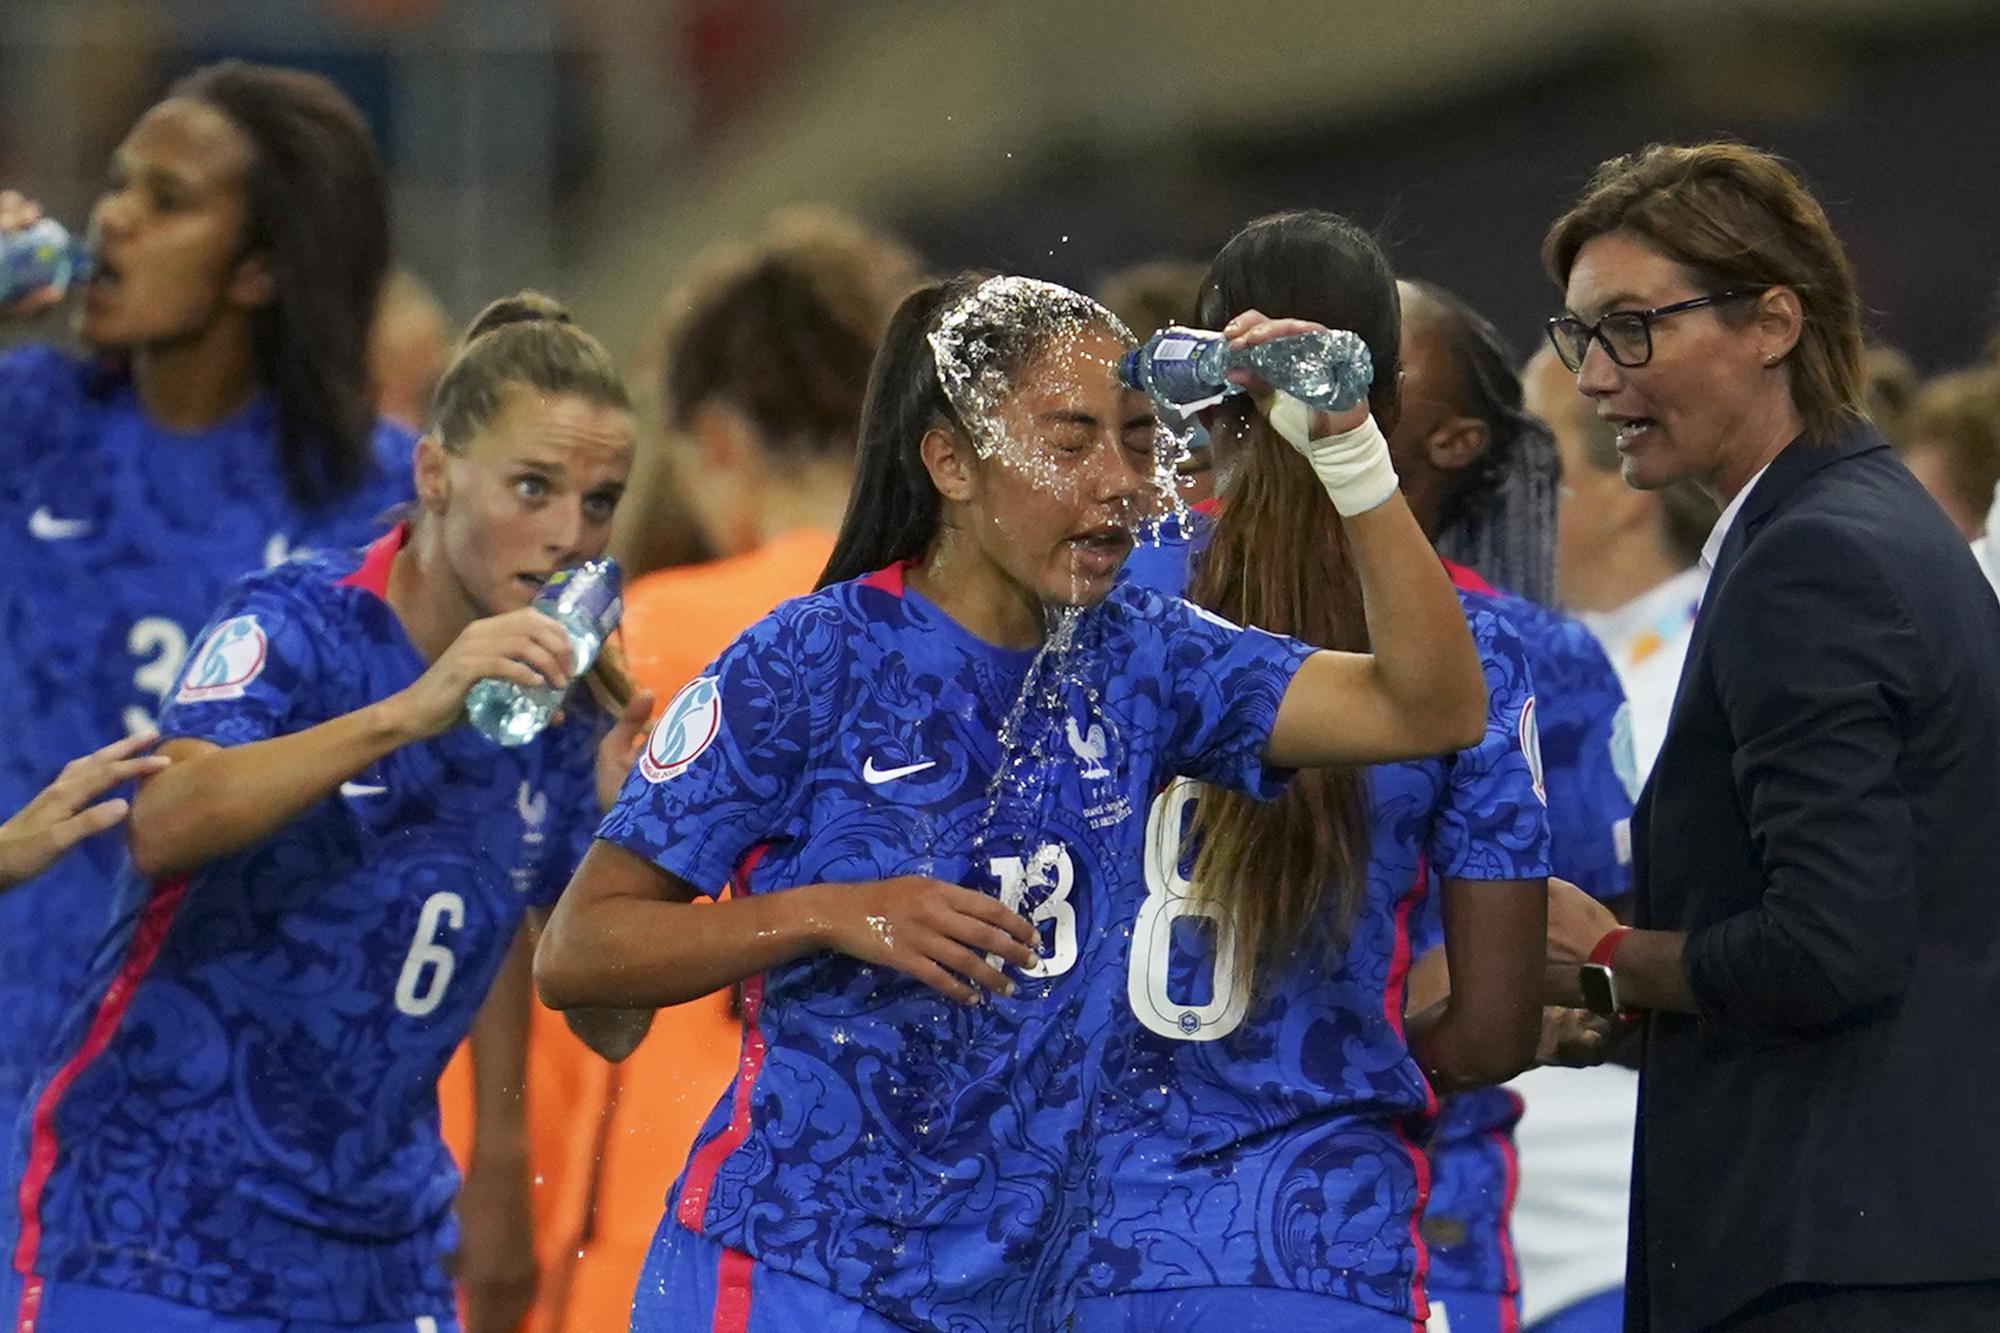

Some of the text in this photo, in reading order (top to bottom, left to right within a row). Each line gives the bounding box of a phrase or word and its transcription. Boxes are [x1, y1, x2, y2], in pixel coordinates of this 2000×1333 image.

[394, 890, 465, 1018] 6
[986, 841, 1078, 979] 13
[1128, 776, 1250, 1041] 8
